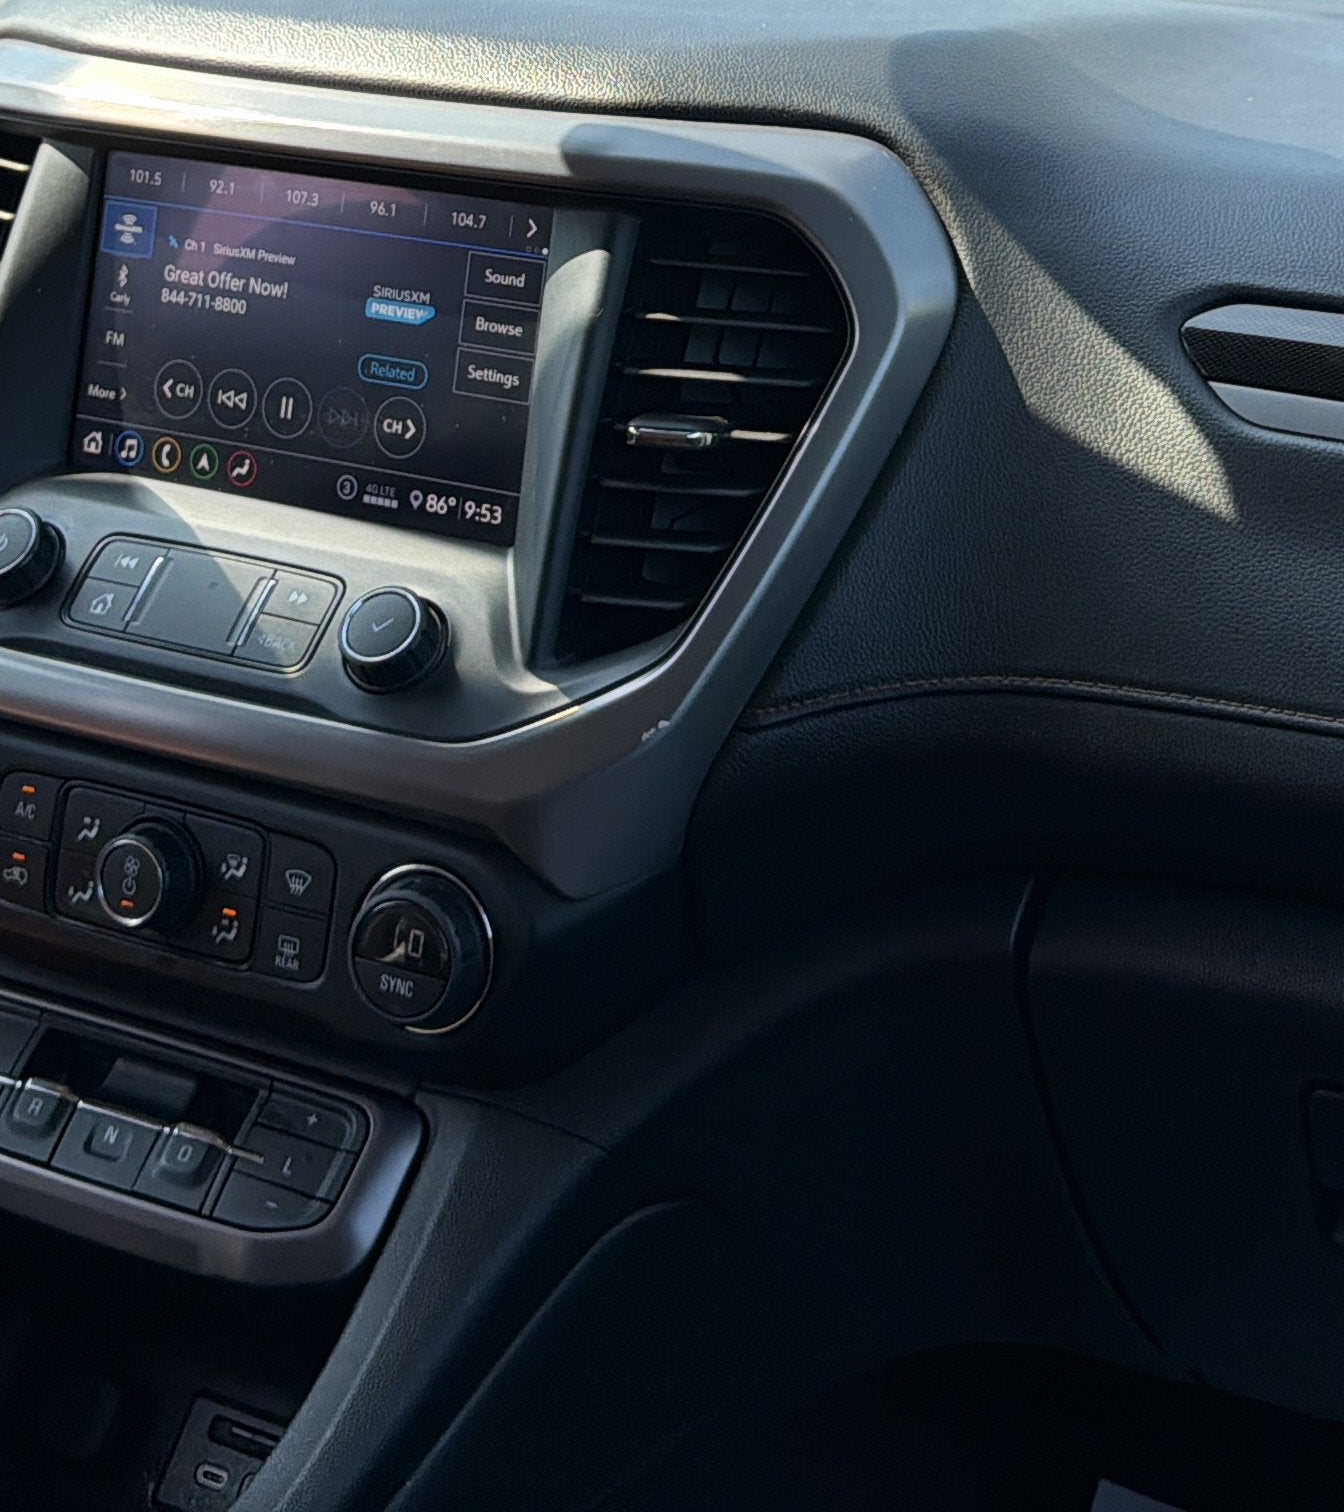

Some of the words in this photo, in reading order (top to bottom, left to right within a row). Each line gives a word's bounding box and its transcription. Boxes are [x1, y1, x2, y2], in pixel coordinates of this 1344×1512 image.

[129, 168, 162, 186] 101.5
[209, 178, 235, 195] 92.1
[286, 189, 320, 207] 107.3
[370, 200, 397, 218] 96.1
[451, 211, 488, 230] 104.7
[184, 238, 199, 252] Ch
[213, 242, 256, 261] SiriusXM
[257, 250, 296, 266] Preview
[163, 264, 205, 287] Great
[207, 271, 246, 293] Offer
[248, 278, 289, 299] Now!
[484, 268, 526, 288] Sound
[161, 287, 247, 315] 844-711-8800
[370, 301, 430, 320] PREVIEW
[474, 316, 524, 337] Browse
[105, 330, 125, 346] FM
[369, 361, 416, 382] Related
[467, 364, 520, 389] Settings
[87, 383, 116, 400] More
[175, 383, 195, 399] CH
[382, 418, 403, 435] CH
[379, 484, 397, 498] LTE
[463, 500, 503, 525] 9:53
[15, 801, 36, 820] A/C
[274, 954, 300, 971] REAR
[379, 973, 414, 998] SYNC
[104, 1125, 120, 1144] N
